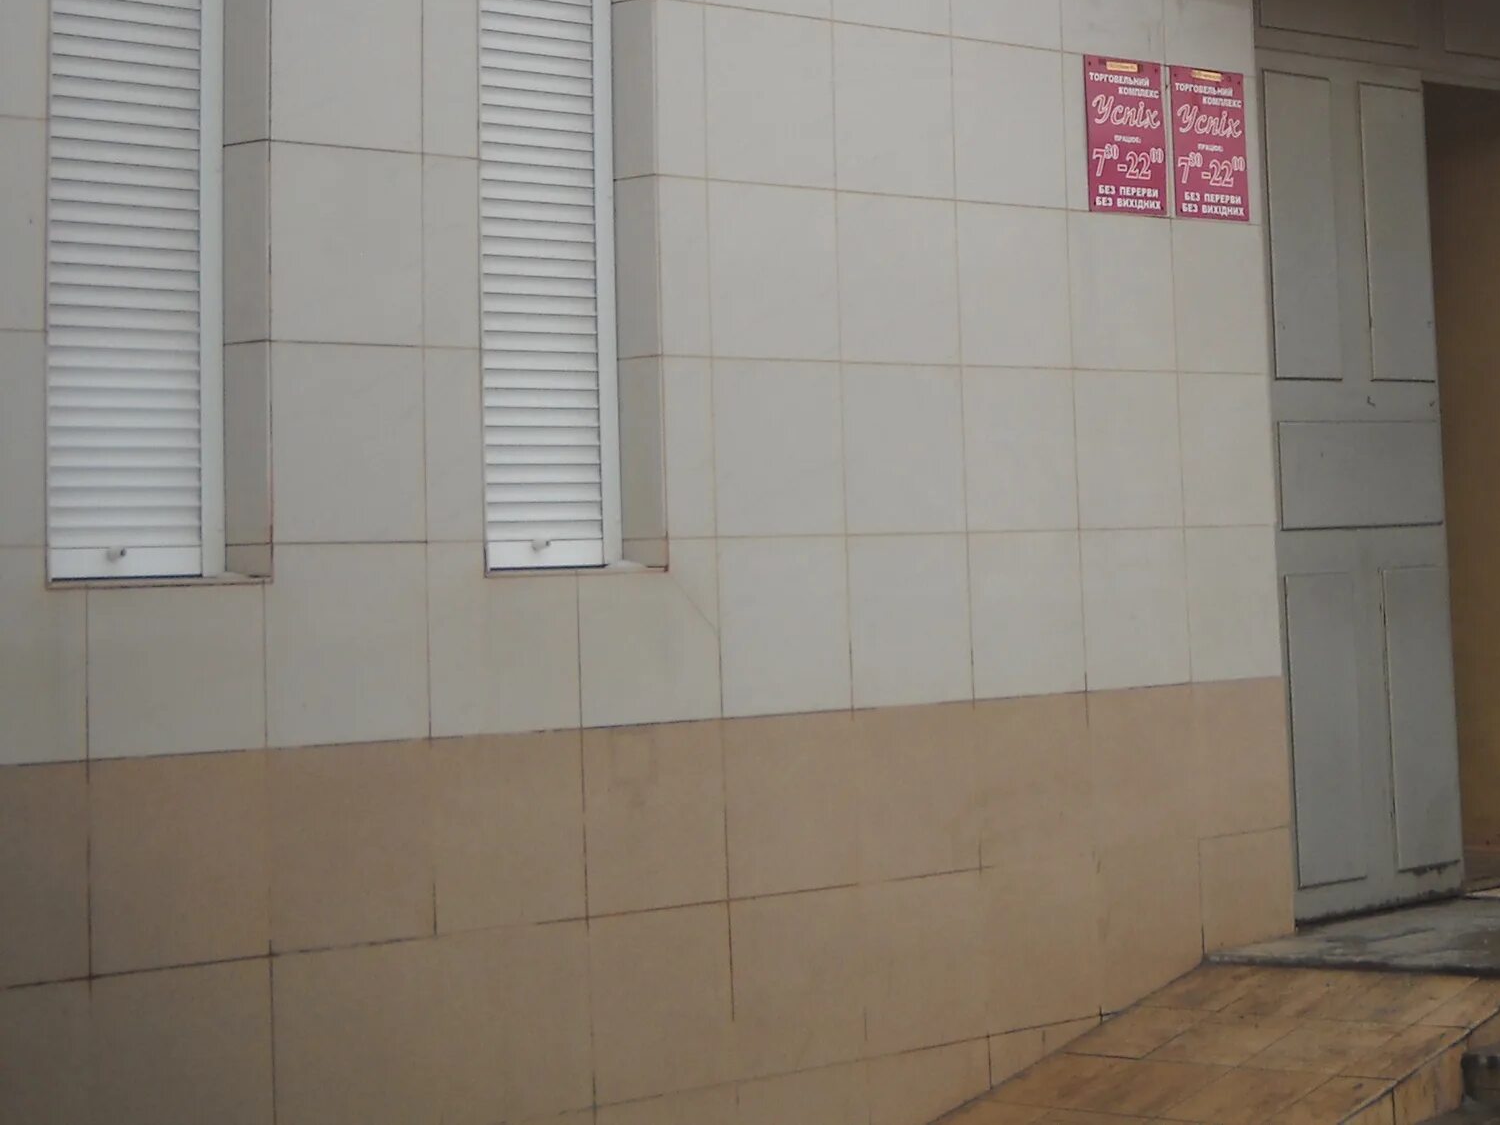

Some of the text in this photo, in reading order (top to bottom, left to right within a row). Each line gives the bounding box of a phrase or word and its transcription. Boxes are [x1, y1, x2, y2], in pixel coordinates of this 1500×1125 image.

[1098, 185, 1158, 198] БЕЗ ПЕРЕРВИ
[1184, 192, 1241, 204] БЕЗ ПЕРЕРВИ
[1096, 196, 1160, 210] БЕЗ ВИХІДНИХ
[1182, 203, 1244, 216] БЕЗ ВИХІДНИХ
